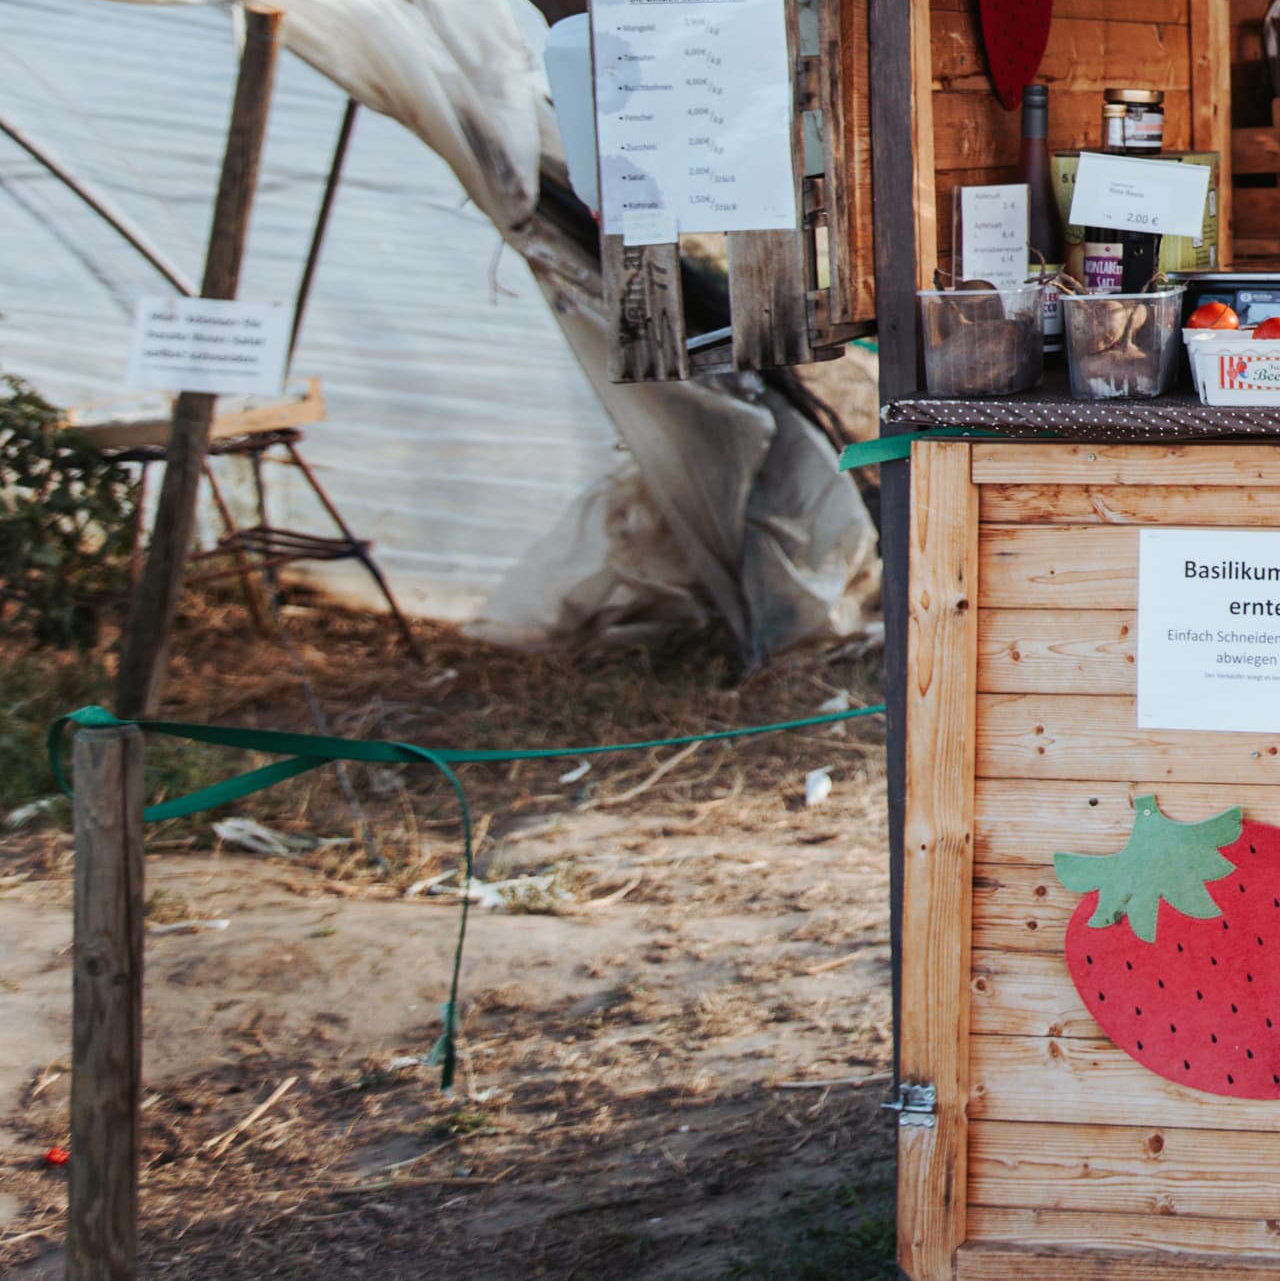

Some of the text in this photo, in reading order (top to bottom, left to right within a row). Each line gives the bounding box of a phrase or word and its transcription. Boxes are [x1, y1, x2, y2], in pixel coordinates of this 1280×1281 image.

[1126, 211, 1149, 225] 2,00
[1152, 216, 1160, 226] €
[1168, 629, 1213, 643] Einfach
[1216, 652, 1277, 668] abwiegen
